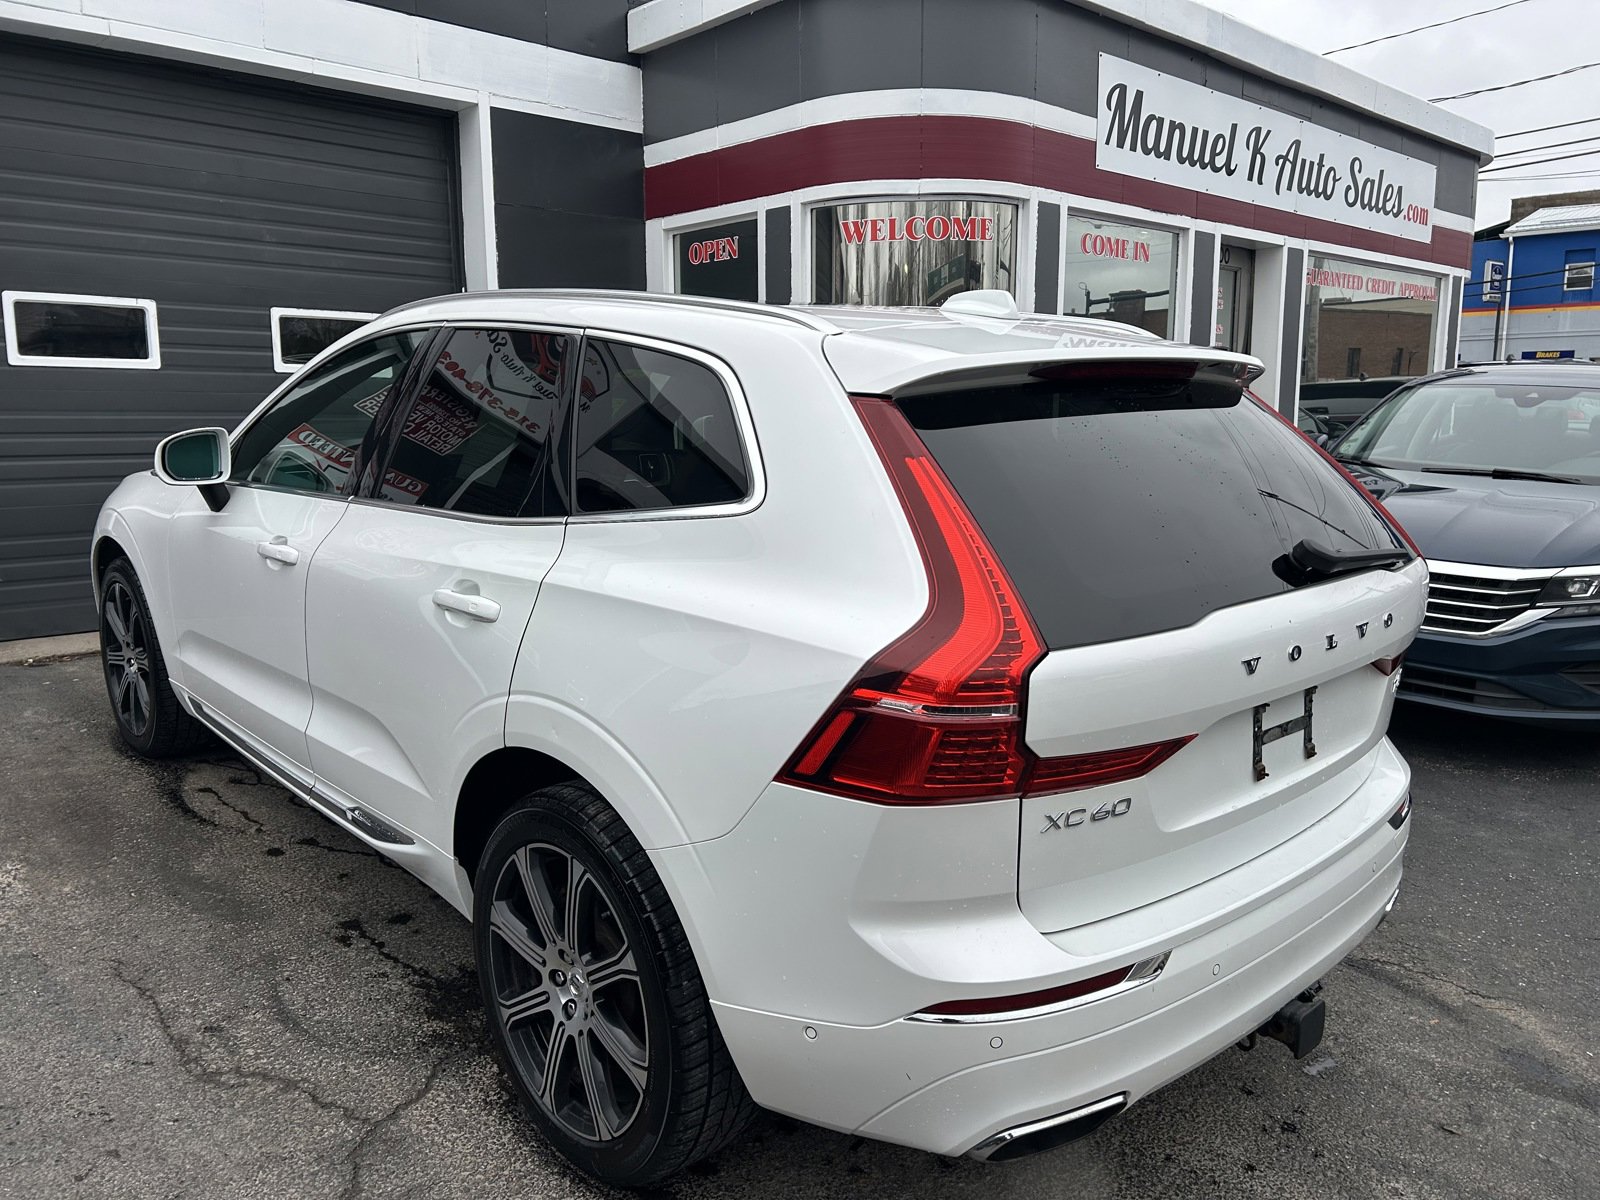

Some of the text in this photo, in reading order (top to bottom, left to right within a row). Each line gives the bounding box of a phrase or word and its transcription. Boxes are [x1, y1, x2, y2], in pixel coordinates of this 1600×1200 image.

[1104, 82, 1238, 177] Manuel
[1245, 126, 1271, 185] K
[1275, 138, 1342, 201] Auto
[840, 214, 994, 246] WELCOME
[688, 235, 740, 266] OPEN
[1080, 232, 1150, 263] COME IN
[1366, 277, 1397, 295] CREDIT
[1399, 282, 1438, 301] APPROVAL
[1535, 351, 1561, 359] BRAKES
[1240, 612, 1394, 676] VOLVO
[1039, 797, 1132, 834] XC60
